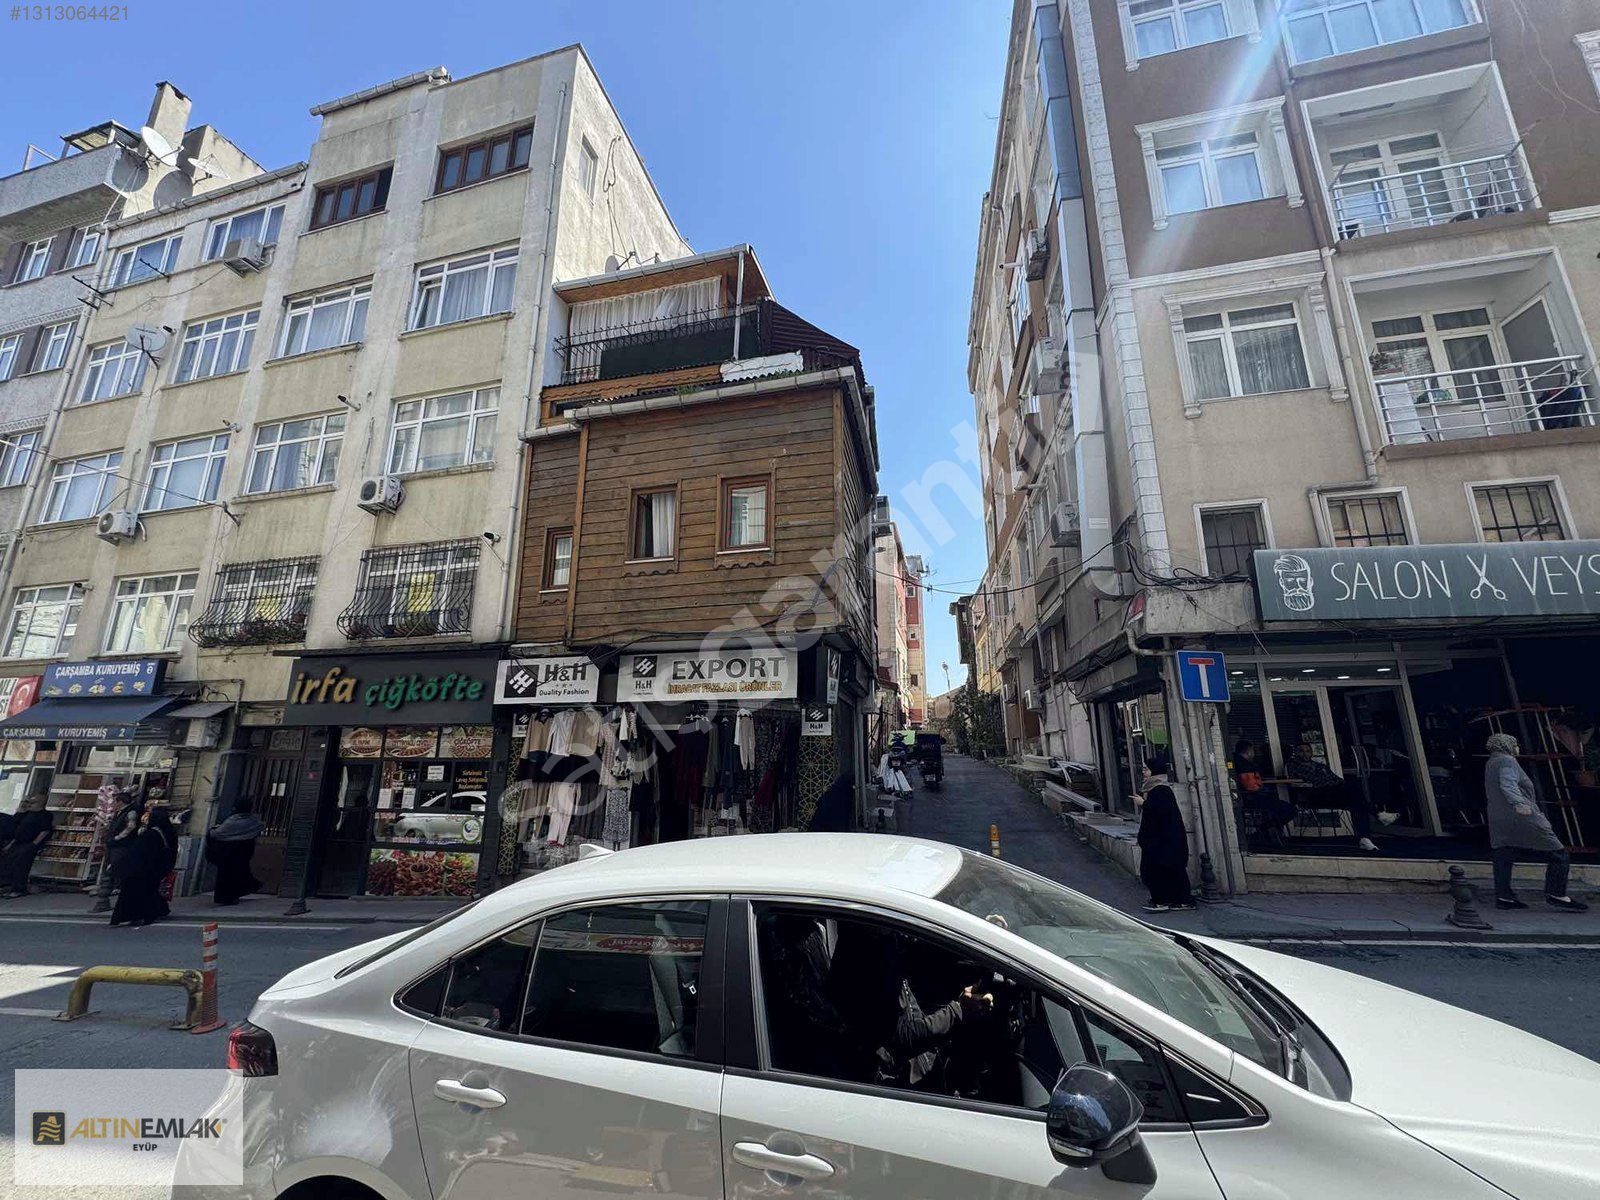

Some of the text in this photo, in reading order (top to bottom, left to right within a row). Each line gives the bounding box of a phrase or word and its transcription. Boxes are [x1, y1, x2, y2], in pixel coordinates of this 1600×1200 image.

[1331, 559, 1452, 601] SALON
[55, 661, 141, 679] ÇARŞAMBA KURUYEMİŞ
[545, 663, 587, 682] H&H
[672, 656, 786, 680] EXPORT
[290, 666, 485, 709] irfa çiğköfte
[539, 688, 590, 697] Quality Fashion
[635, 680, 652, 689] H&H
[57, 726, 108, 738] KURUYEMİŞ
[118, 728, 126, 737] 2
